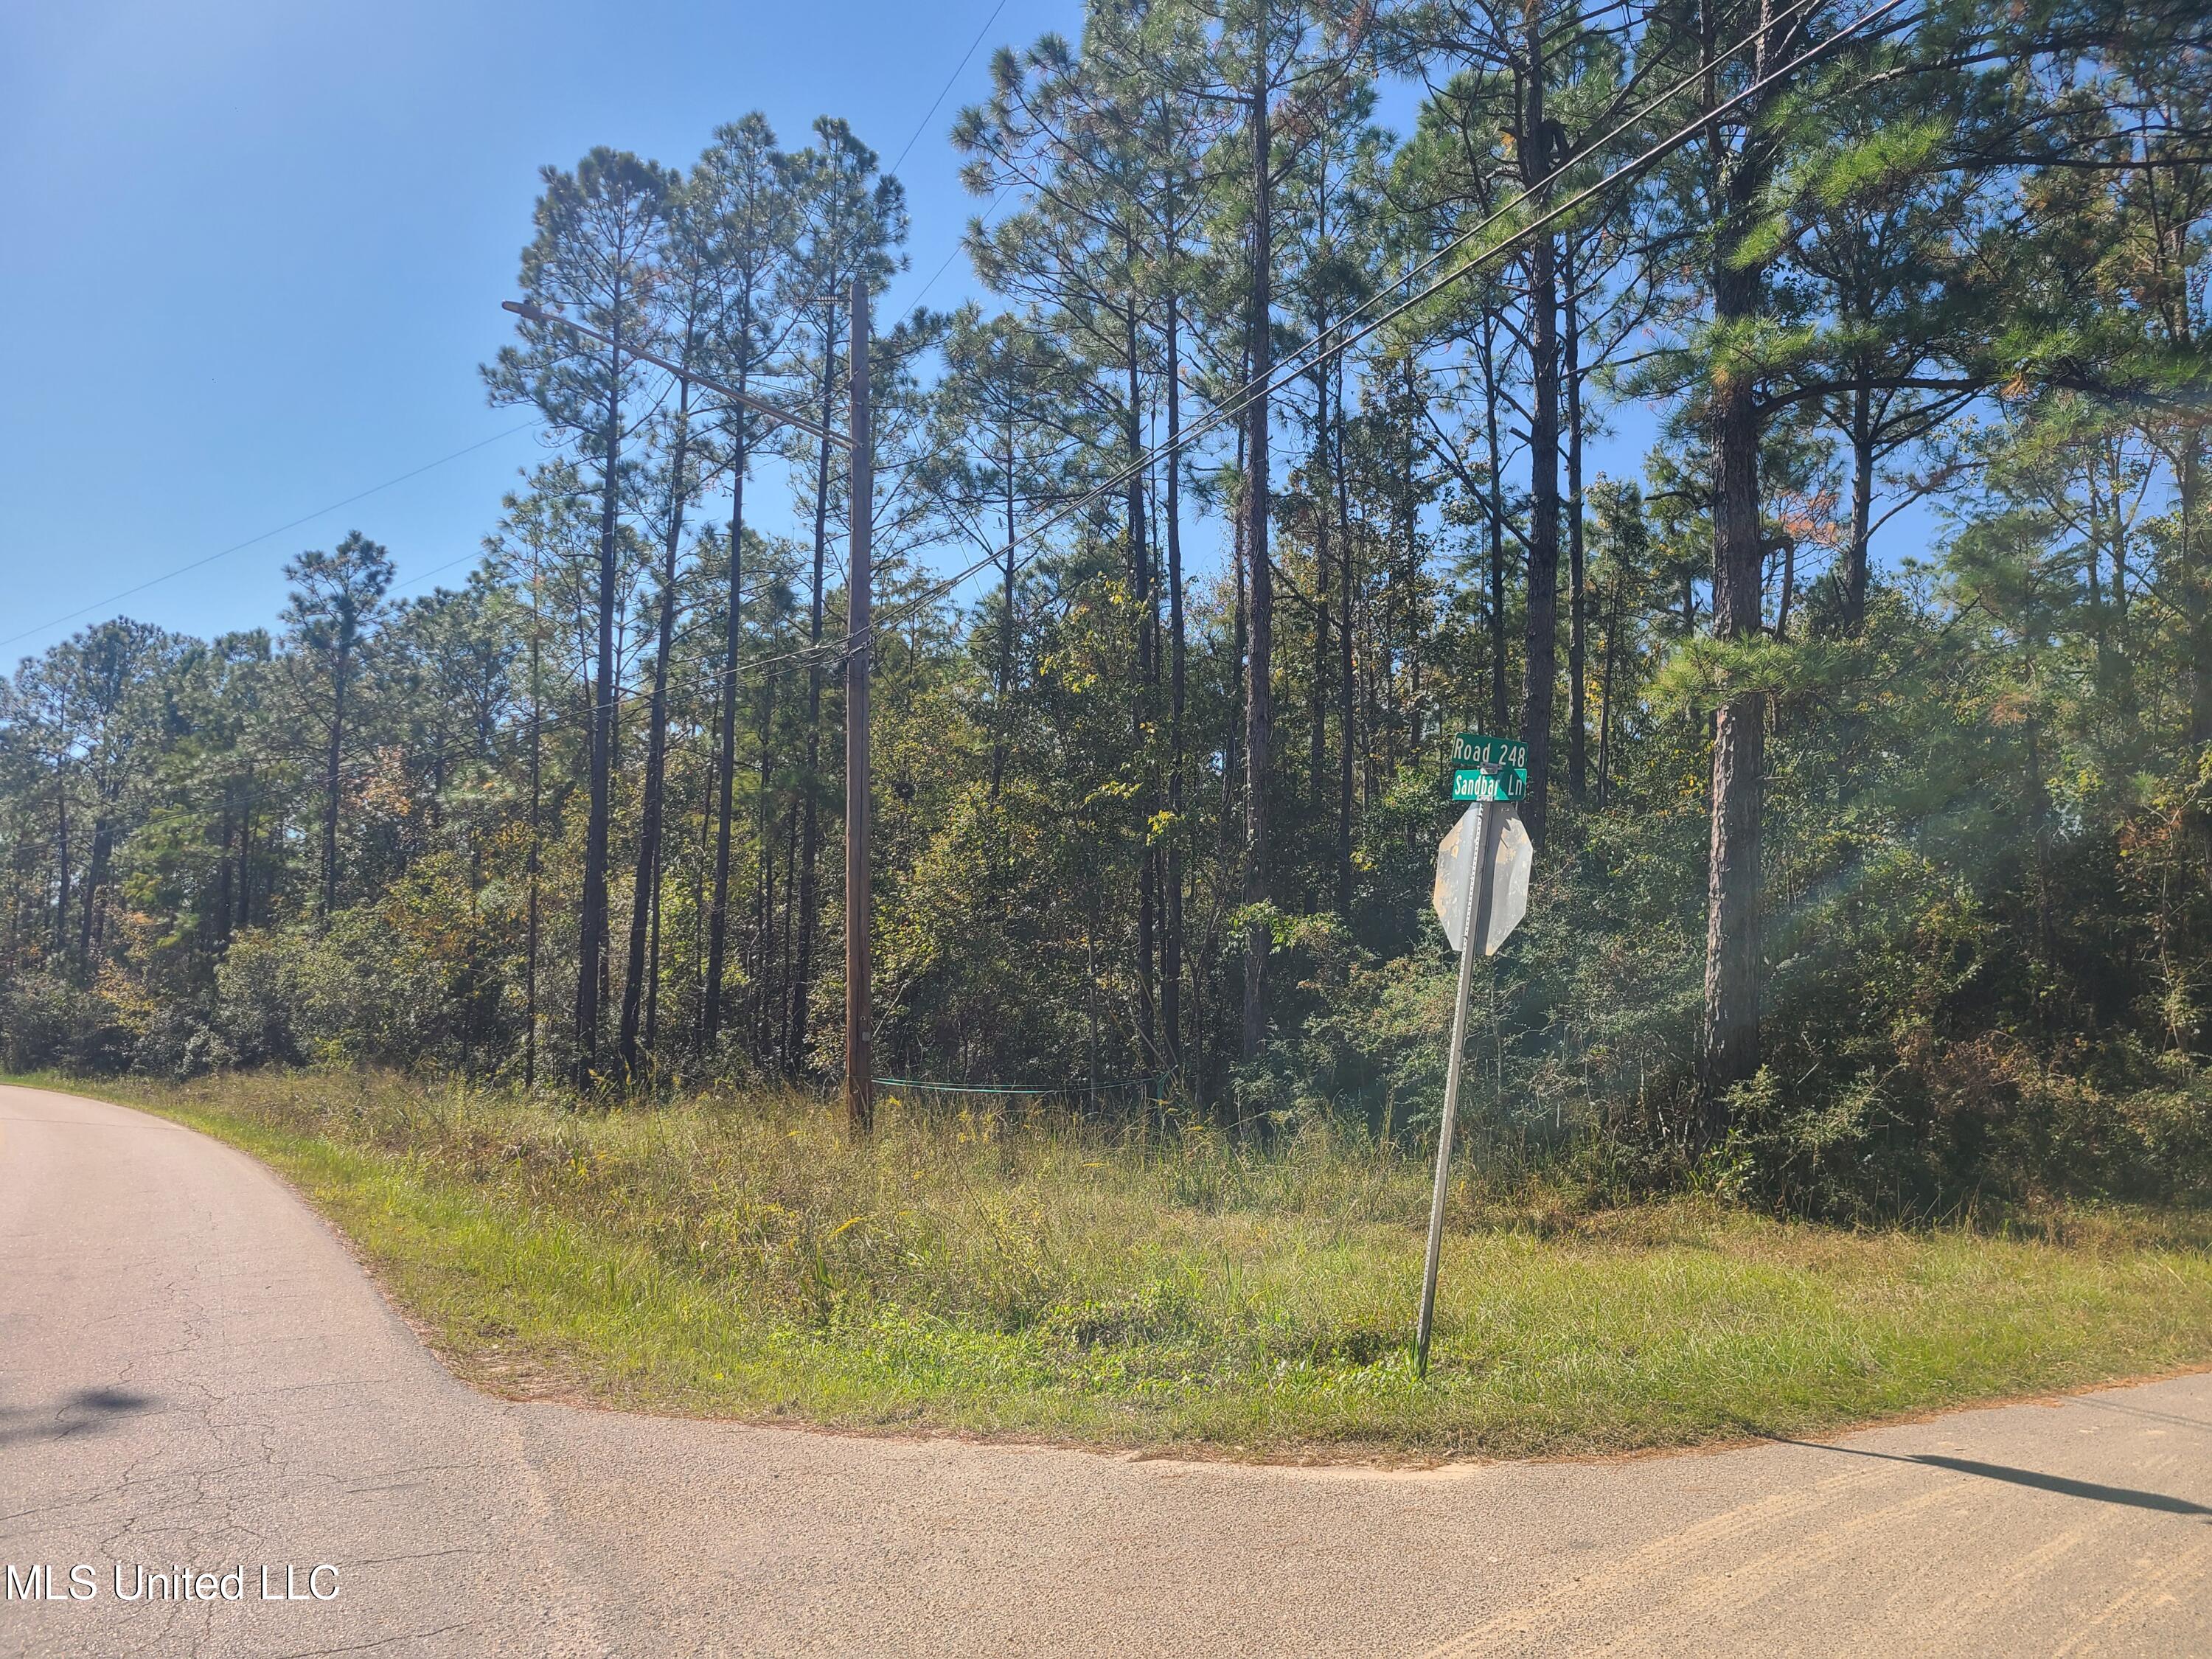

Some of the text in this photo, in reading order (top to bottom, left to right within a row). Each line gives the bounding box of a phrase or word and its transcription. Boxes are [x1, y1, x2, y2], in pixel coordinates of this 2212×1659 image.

[1453, 738, 1526, 768] Road 248
[1455, 774, 1523, 796] Sandbar Ln
